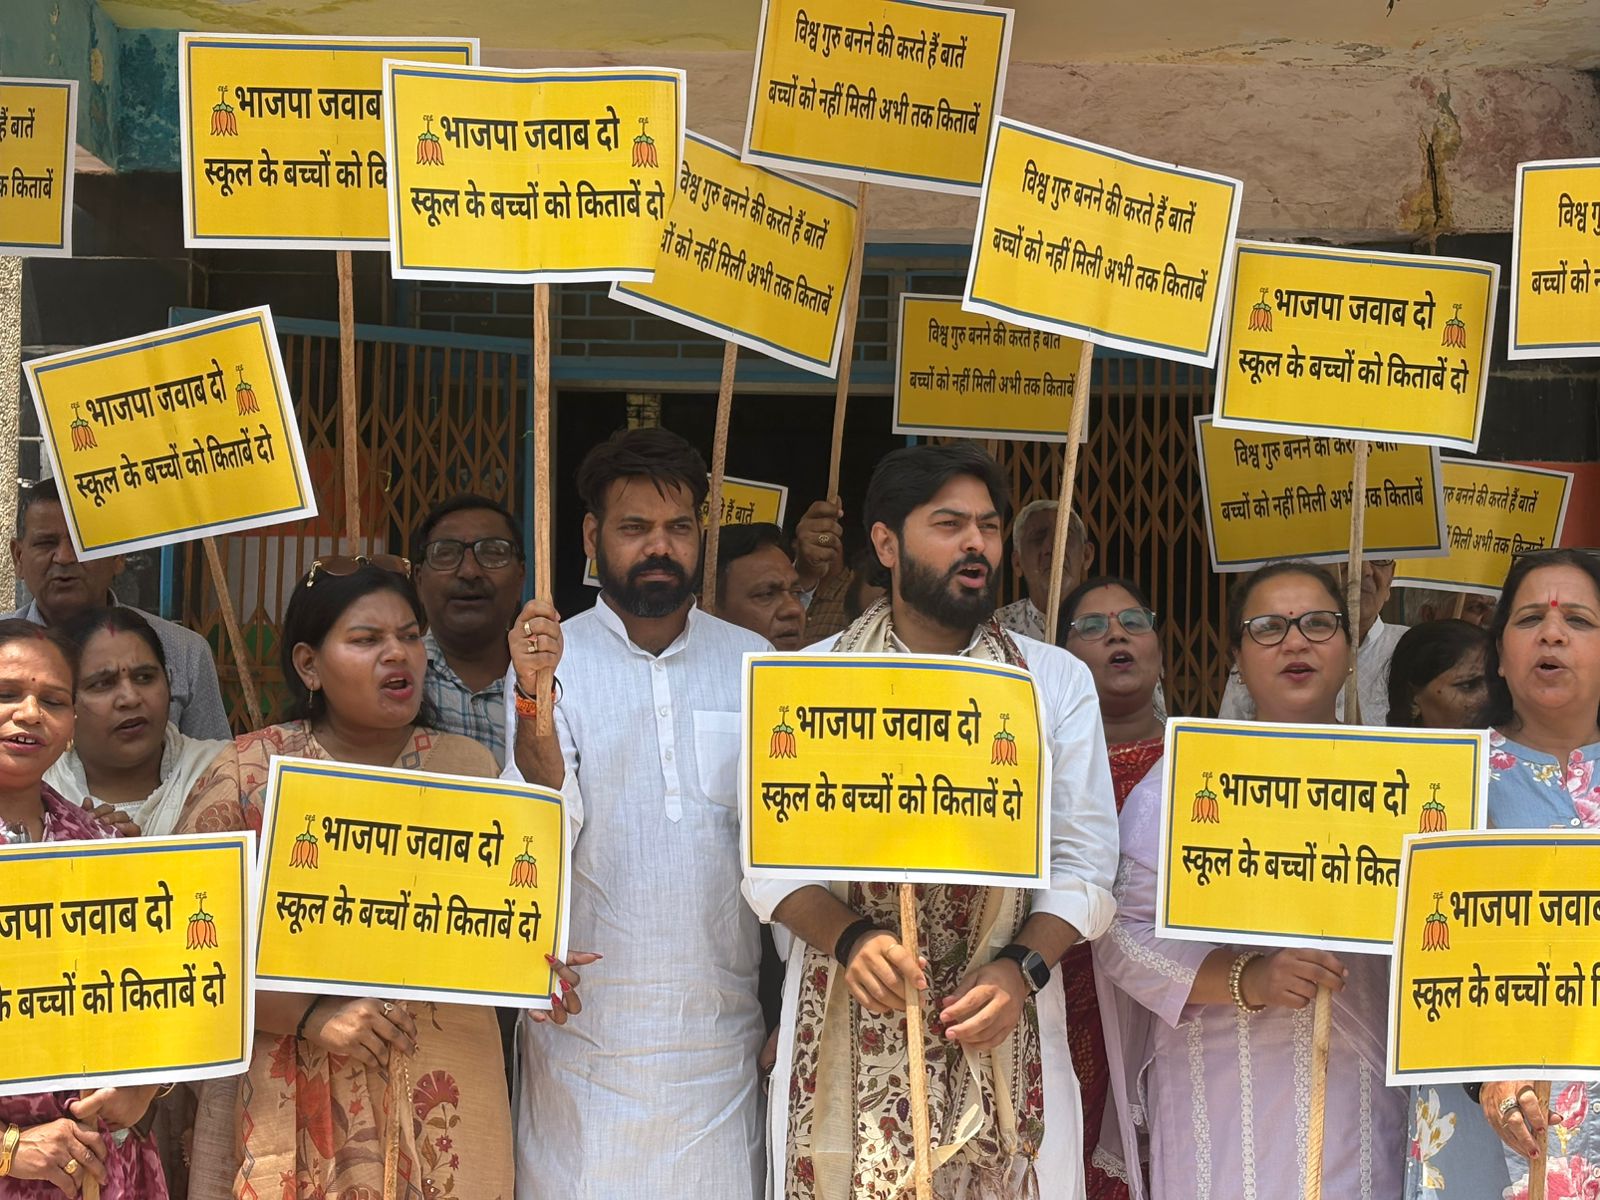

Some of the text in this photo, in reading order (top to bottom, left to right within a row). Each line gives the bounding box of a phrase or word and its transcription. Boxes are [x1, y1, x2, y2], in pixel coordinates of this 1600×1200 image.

[794, 9, 967, 69] विश्व गुरु बनने की करते हैं बातें
[10, 107, 35, 138] बातें
[235, 86, 382, 120] भाजपा जवाब
[768, 76, 980, 134] बच्चों को नहीं मिली अभी तक किताबें
[440, 105, 620, 151] भाजपा जवाब दो
[11, 167, 53, 198] किताबें
[204, 158, 253, 196] स्कूल
[257, 148, 278, 186] के
[282, 149, 330, 187] बच्चों
[335, 150, 362, 188] को
[410, 179, 665, 226] स्कूल के बच्चों को किताबें दो
[701, 179, 830, 250] गुरु बनने की करते हैं बातें
[1022, 159, 1196, 234] विश्व गुरु बनने की करते हैं बातें
[1558, 192, 1588, 233] विश्व
[674, 228, 693, 260] को
[694, 237, 718, 271] नहीं
[715, 242, 746, 281] मिली
[747, 261, 773, 292] अभी
[773, 273, 794, 300] तक
[793, 274, 834, 315] किताबें
[992, 226, 1208, 302] बच्चों को नहीं मिली अभी तक किताबें
[1531, 260, 1567, 294] बच्चों
[1570, 259, 1590, 293] को
[1274, 288, 1436, 330] भाजपा जवाब दो
[928, 318, 949, 347] विश्व
[951, 326, 966, 350] गुरु
[968, 320, 991, 345] बनने
[993, 321, 1006, 345] की
[86, 358, 226, 426] भाजपा जवाब दो
[909, 365, 1075, 397] बच्चों को नहीं मिली अभी तक किताबें
[1239, 344, 1469, 394] स्कूल के बच्चों को किताबें दो
[73, 424, 274, 507] स्कूल के बच्चों को किताबें दो
[1234, 438, 1260, 469] विश्व
[1261, 441, 1280, 471] गुरु
[1220, 492, 1250, 521] बच्चों
[1252, 490, 1269, 517] को
[1271, 487, 1294, 519] नहीं
[1296, 484, 1326, 513] मिली
[1384, 477, 1424, 507] किताबें
[1455, 483, 1476, 505] बनने
[1475, 484, 1488, 506] की
[1488, 486, 1510, 509] करते
[1508, 487, 1519, 513] हैं
[1518, 490, 1539, 513] बातें
[1449, 525, 1472, 549] मिली
[1472, 529, 1493, 551] अभी
[1492, 536, 1511, 554] तक
[797, 698, 981, 745] भाजपा जवाब दो
[761, 771, 1023, 822] स्कूल के बच्चों को किताबें दो
[1220, 769, 1409, 816] भाजपा जवाब दो
[322, 816, 504, 867] भाजपा जवाब दो
[1182, 838, 1351, 886] स्कूल के बच्चों को
[0, 880, 173, 940] जपा जवाब दो
[276, 884, 541, 943] स्कूल के बच्चों को किताबें दो
[1451, 890, 1532, 927] भाजपा
[17, 972, 76, 1018] बच्चों
[81, 969, 114, 1014] को
[120, 963, 196, 1011] किताबें
[201, 961, 226, 1007] दो
[1412, 976, 1463, 1022] स्कूल
[1468, 962, 1490, 1007] के
[1494, 962, 1550, 1006] बच्चों
[1555, 961, 1585, 1006] को
